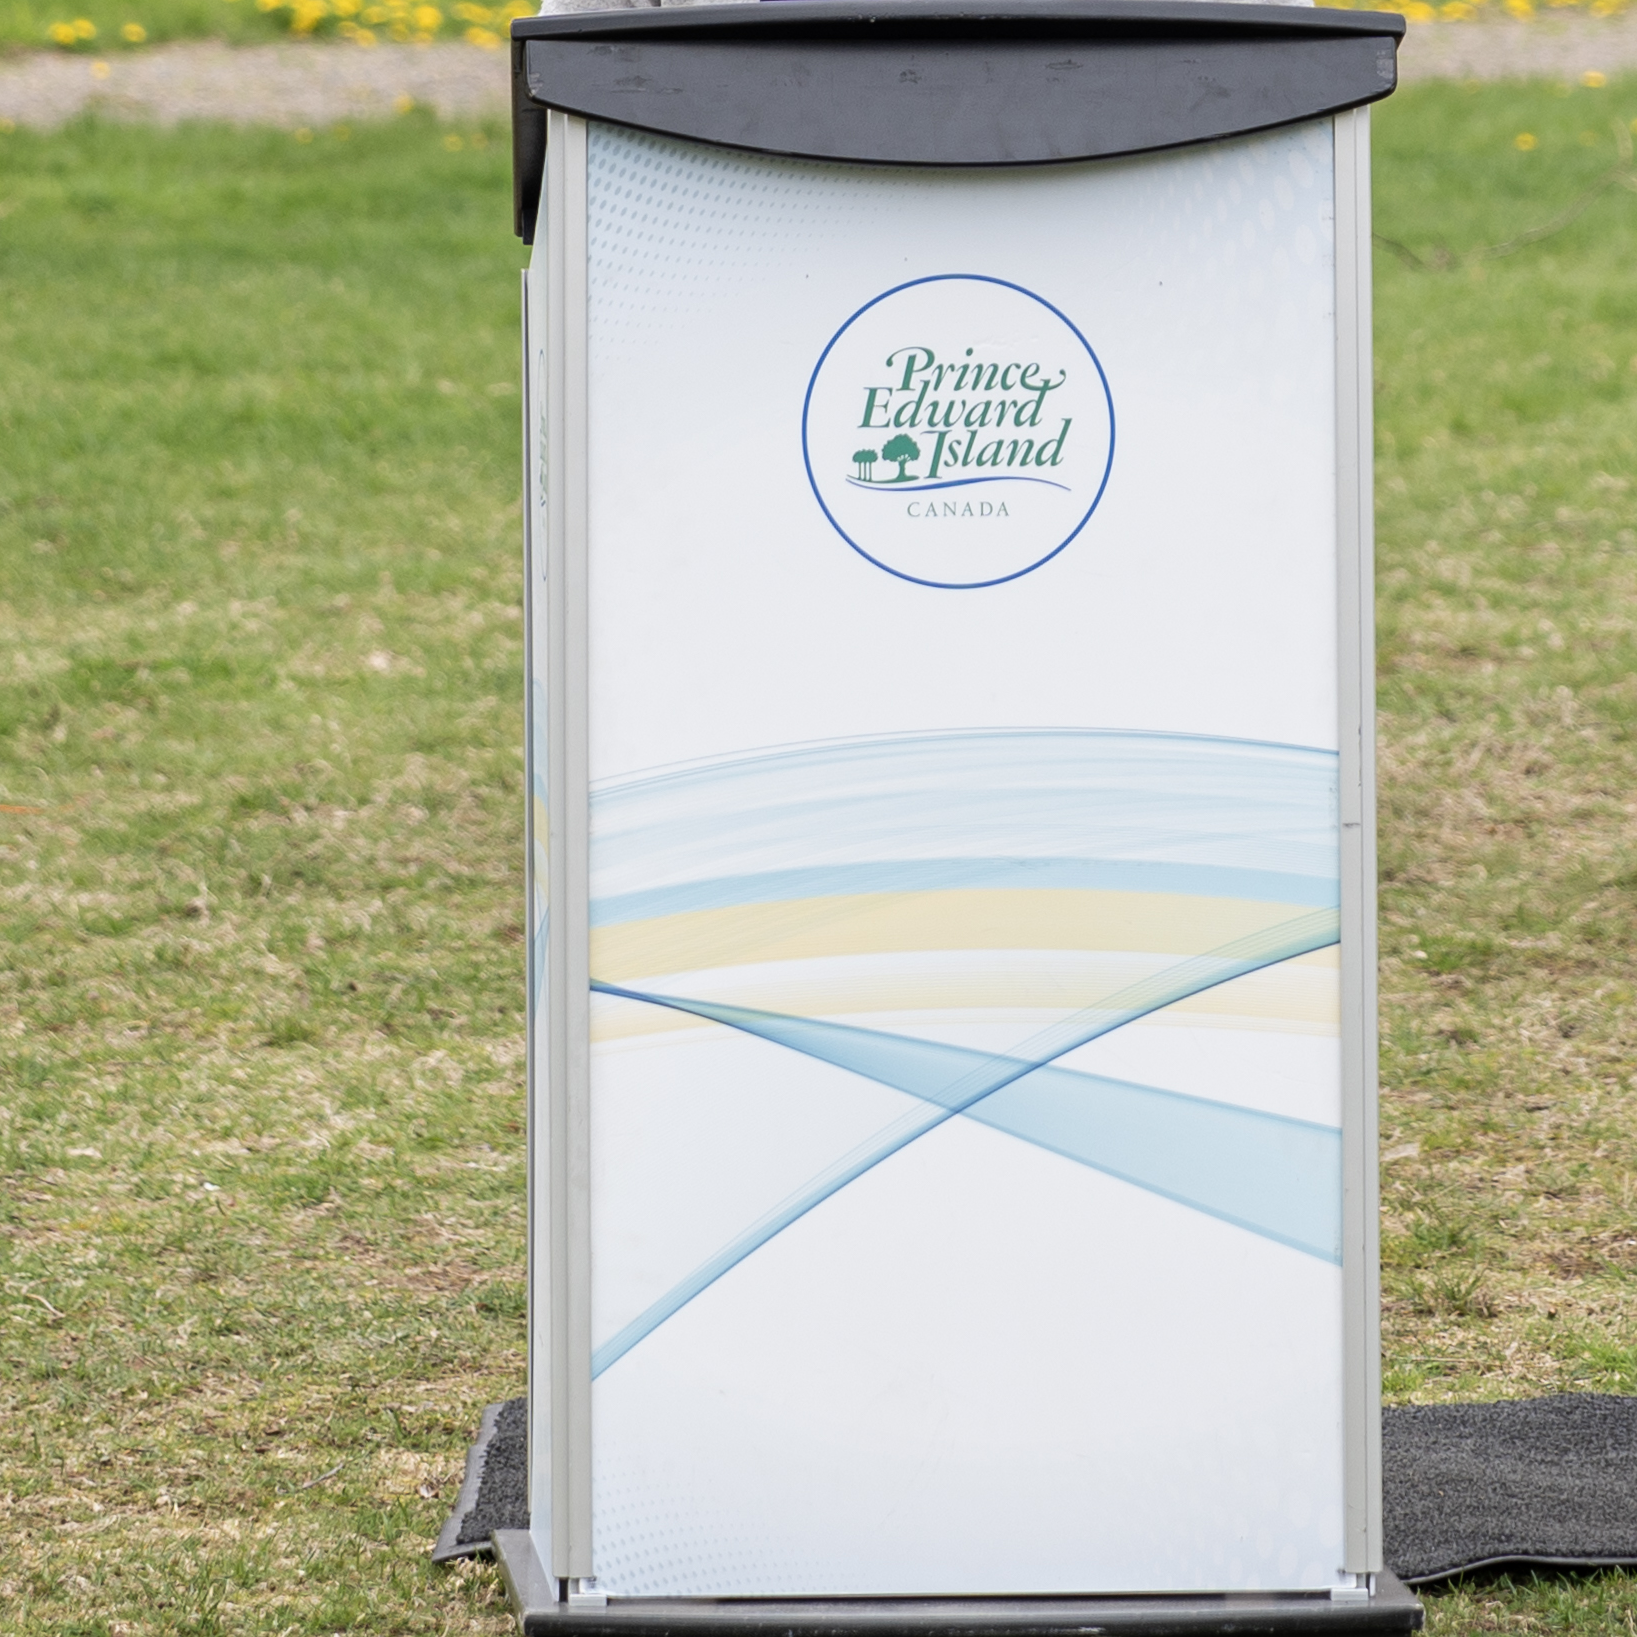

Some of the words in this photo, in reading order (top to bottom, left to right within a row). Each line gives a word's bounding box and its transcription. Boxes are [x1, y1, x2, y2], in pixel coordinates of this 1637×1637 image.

[886, 347, 1066, 391] Prince
[858, 379, 1051, 428] Edward
[920, 418, 1073, 479] Island
[907, 502, 1009, 517] CANADA
